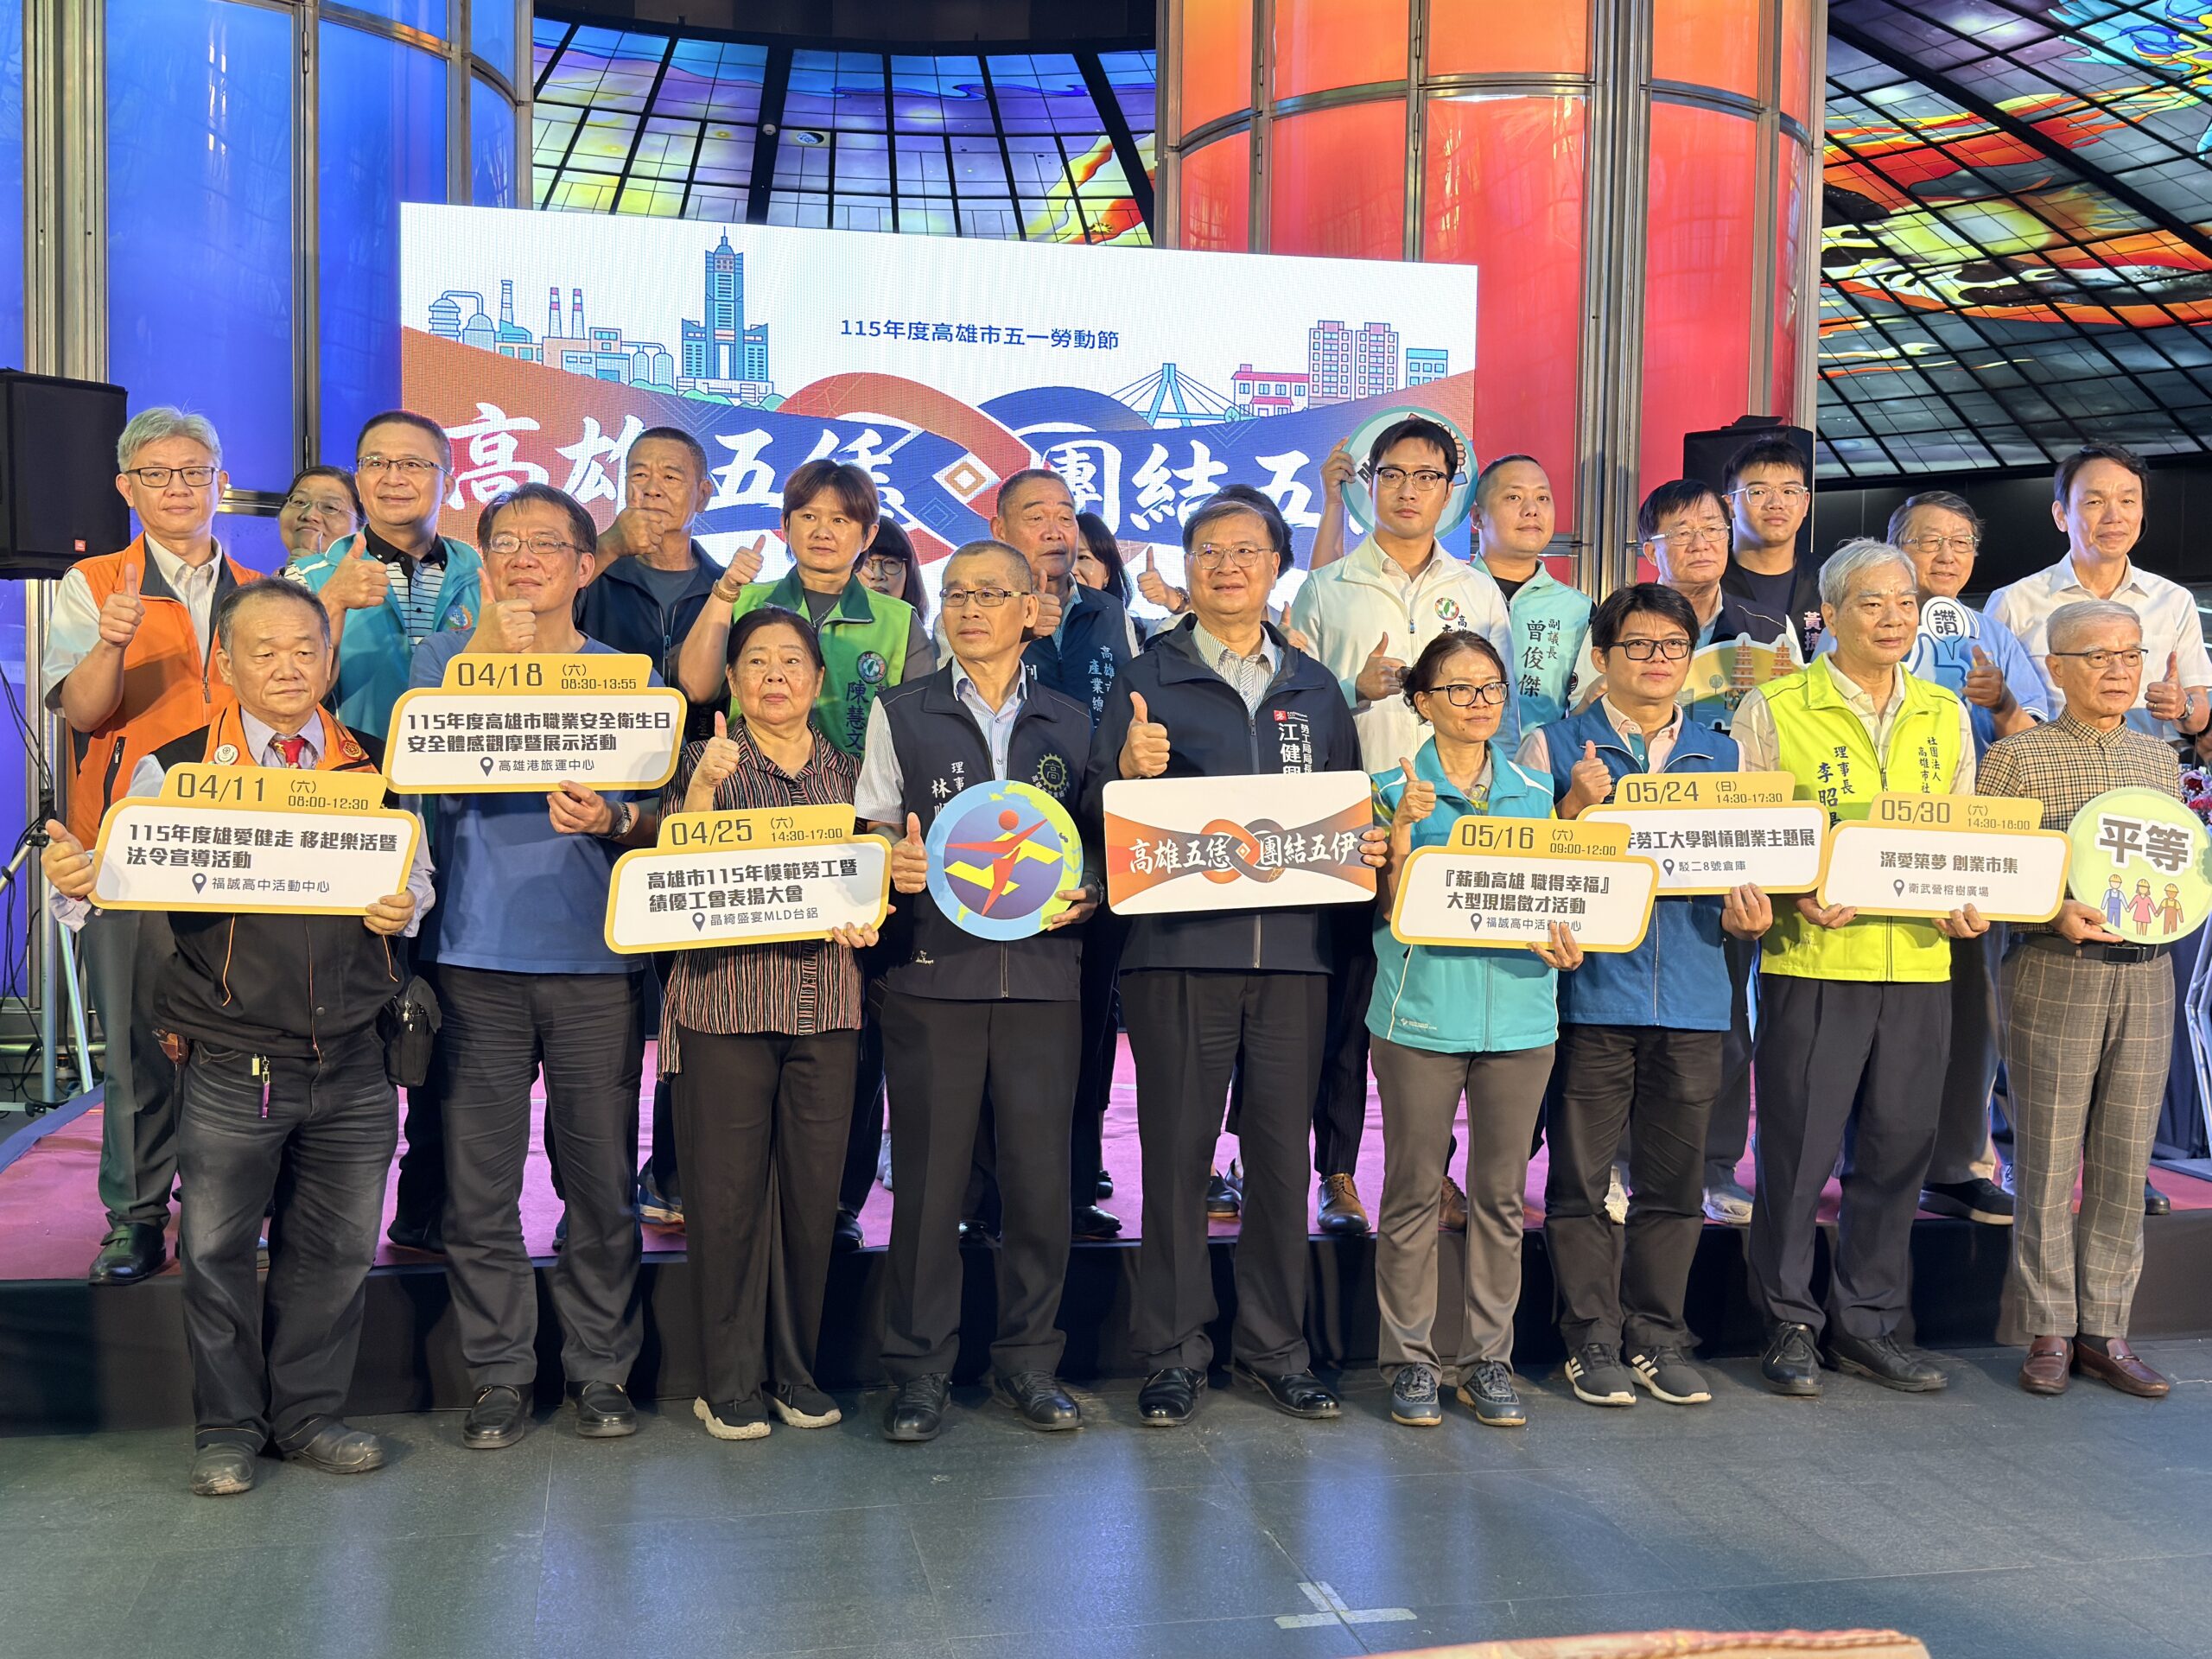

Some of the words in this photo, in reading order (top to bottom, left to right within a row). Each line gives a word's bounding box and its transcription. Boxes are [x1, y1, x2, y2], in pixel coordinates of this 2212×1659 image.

[841, 320, 1119, 350] 115年度高雄市五一勞動節
[1040, 439, 1365, 536] 團結五
[1457, 614, 1467, 632] 高
[1934, 610, 1959, 635] 讚
[1546, 619, 1560, 660] 副議長
[1518, 620, 1547, 697] 曾俊傑
[458, 663, 543, 689] 04/18
[562, 664, 588, 677] (六)
[561, 678, 637, 690] 08:30-13:55
[408, 711, 671, 730] 115年度高雄市職業安全衛生日
[408, 734, 617, 753] 安全體感觀摩暨展示活動
[499, 759, 595, 772] 高雄港旅運中心
[951, 761, 965, 791] 理事
[1834, 746, 1856, 795] 理事長
[177, 772, 264, 804] 04/11
[290, 779, 317, 794] (六)
[1626, 781, 1699, 804] 05/24
[1715, 781, 1737, 792] (日)
[1716, 793, 1783, 804] 14:30-17:30
[288, 796, 369, 810] 08:00-12:30
[1881, 799, 1950, 823] 05/30
[1967, 804, 1988, 817] (六)
[671, 819, 752, 846] 04/25
[771, 817, 793, 830] (六)
[771, 828, 843, 842] 14:30-17:00
[1967, 817, 2030, 830] 14:30-18:00
[129, 823, 294, 849] 115年度雄愛健走
[300, 831, 397, 852] 移起樂活暨
[1462, 824, 1535, 849] 05/16
[1552, 830, 1573, 842] (六)
[2100, 817, 2190, 872] 平等
[127, 846, 251, 869] 法令宣導活動
[1128, 836, 1230, 874] 高雄五恁
[1260, 831, 1358, 868] 團結五伊
[1549, 843, 1617, 855] 09:00-12:00
[647, 858, 858, 890] 高雄市115年模範勞工暨
[1679, 861, 1746, 873] 駁二8號倉庫
[1880, 851, 1948, 870] 深愛築夢
[1953, 855, 2018, 874] 創業市集
[212, 876, 330, 893] 福誠高中活動中心
[1446, 869, 1525, 890] 『薪動高雄
[1531, 874, 1610, 894] 職得幸福』
[1909, 883, 1989, 898] 衛武營榕樹廣場
[649, 885, 804, 912] 績優工會表揚大會
[1446, 893, 1586, 914] 大型現場徵才活動
[710, 907, 818, 926] 晶綺盛宴MLD台鋁
